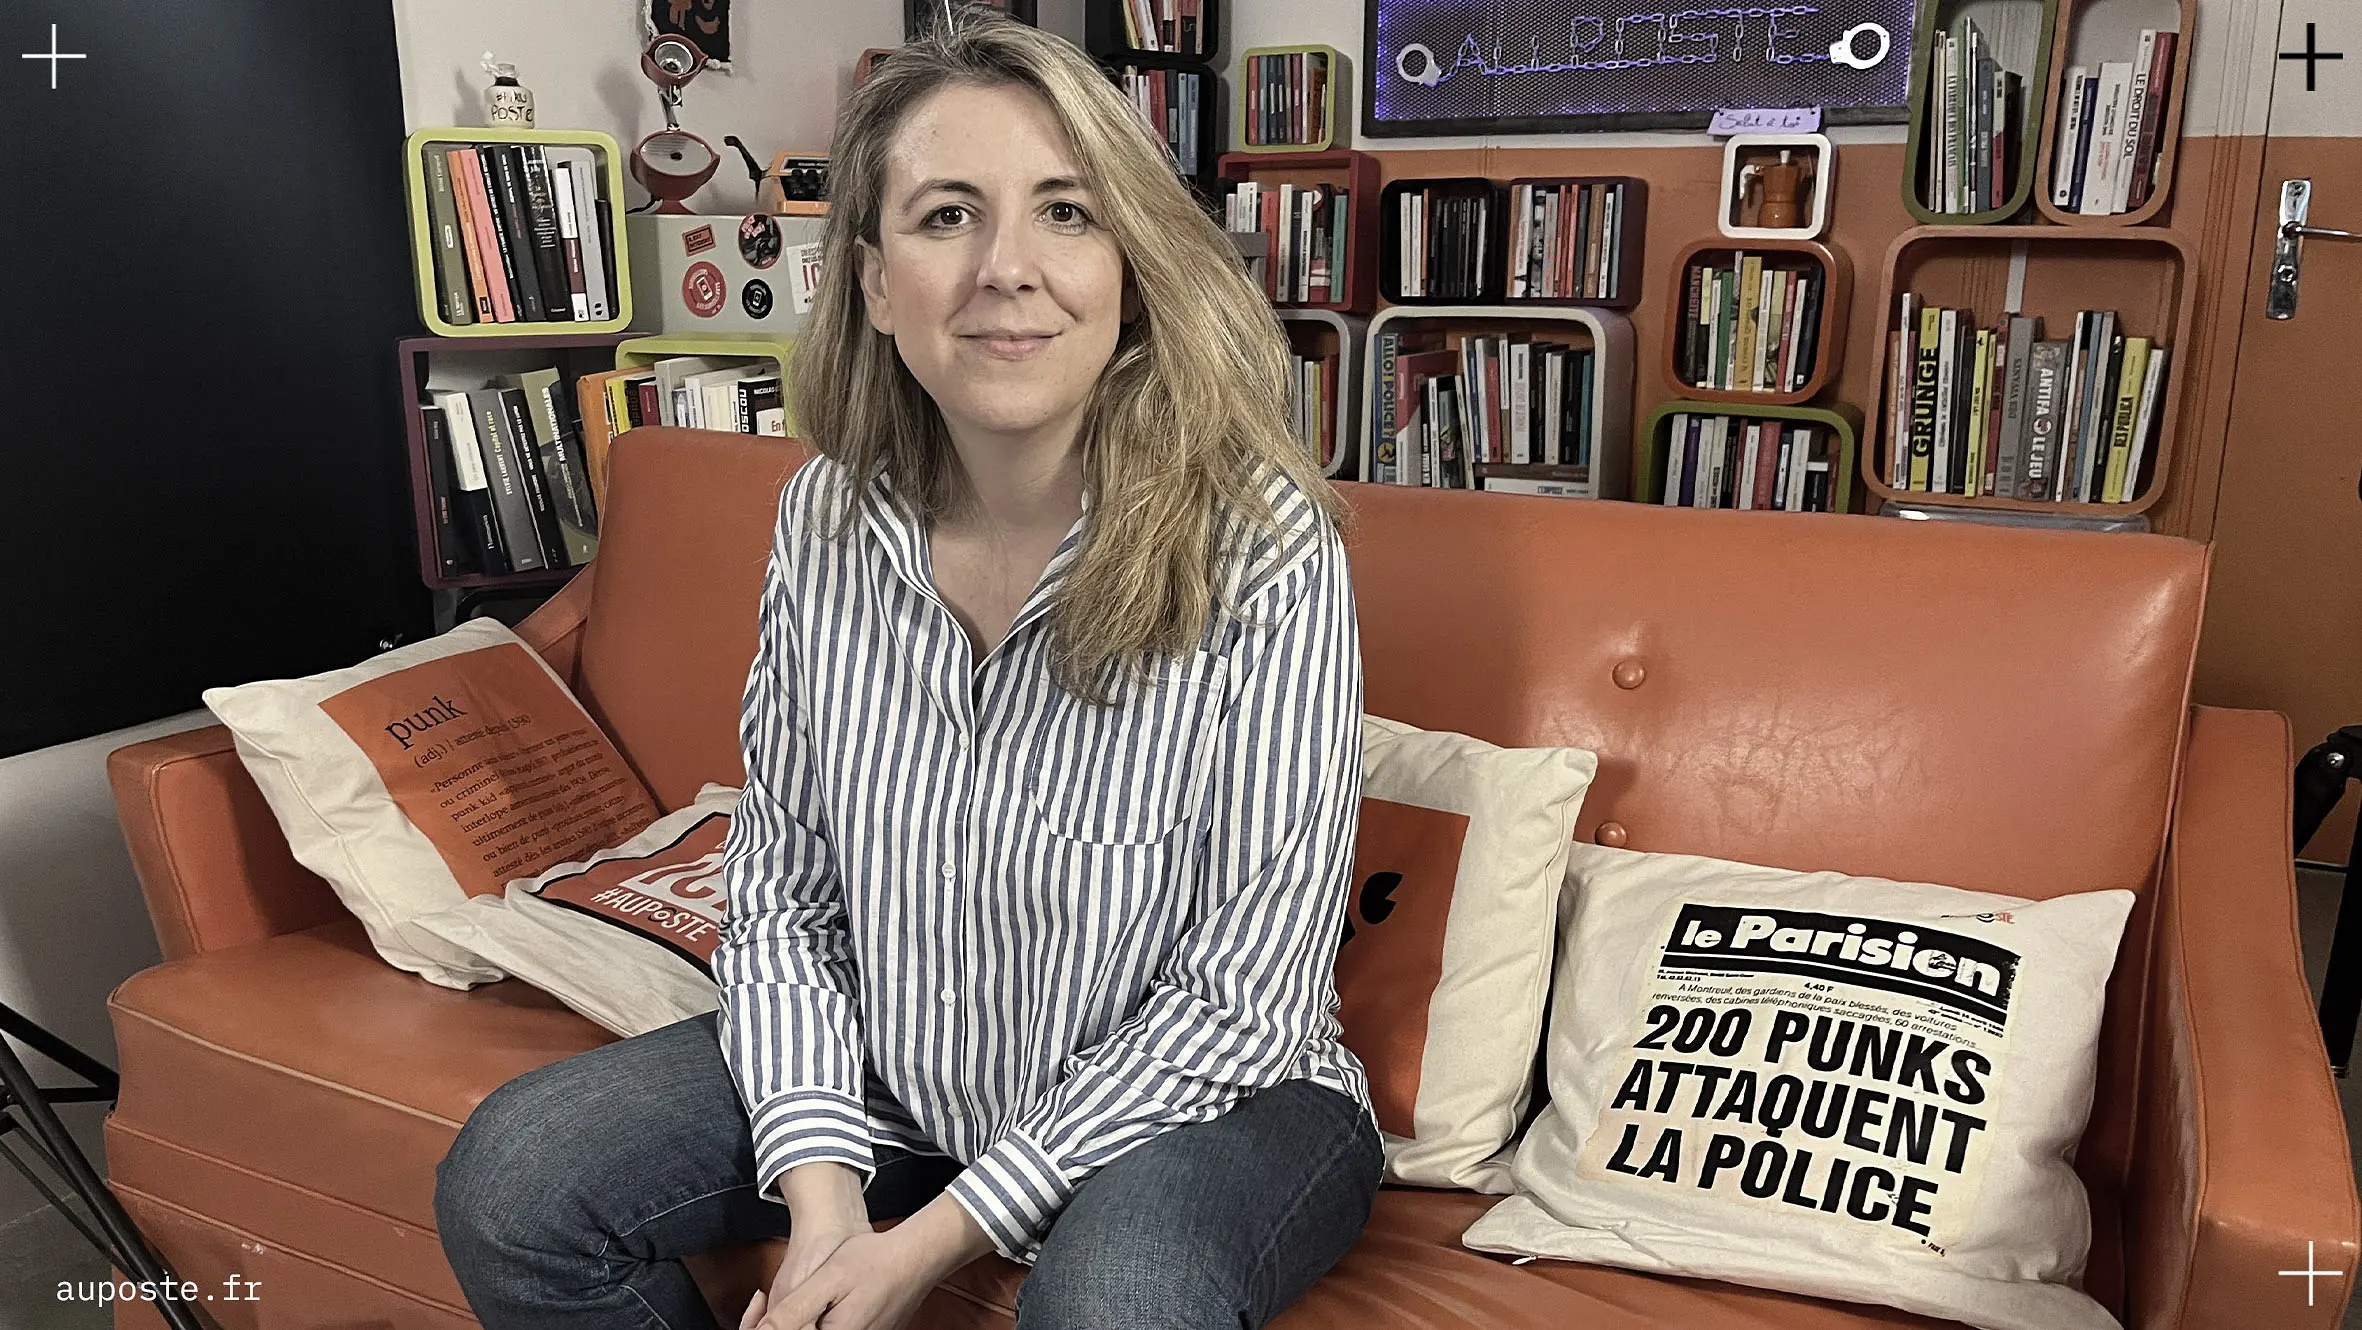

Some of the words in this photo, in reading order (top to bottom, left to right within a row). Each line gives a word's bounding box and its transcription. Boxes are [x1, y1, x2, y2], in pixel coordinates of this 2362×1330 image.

[2130, 87, 2144, 119] DROIT
[2124, 138, 2136, 159] SOL
[1913, 347, 1938, 458] GRUNGE
[2036, 368, 2053, 416] ANTIFA
[542, 387, 566, 462] MULTINATIONALES
[2028, 450, 2044, 479] JEU
[385, 696, 467, 750] punk
[414, 744, 448, 768] (adj.)
[440, 798, 455, 808] ou
[455, 770, 499, 802] criminel
[1681, 920, 1722, 948] le
[1729, 915, 2000, 996] Parisien
[1687, 985, 1733, 995] Montreuil,
[1735, 987, 1751, 995] des
[1753, 987, 1796, 998] gardiens
[1798, 991, 1810, 999] de
[1813, 993, 1823, 1001] la
[1825, 995, 1847, 1009] paix
[1849, 1000, 1889, 1015] blessés,
[1892, 1009, 1912, 1019] des
[1914, 1013, 1957, 1031] voitures
[1705, 995, 1721, 1004] des
[1895, 1018, 1909, 1028] 60
[1633, 1005, 1753, 1057] 200
[1764, 1010, 1991, 1105] PUNKS
[1611, 1058, 1987, 1174] ATTAQUENT
[1606, 1123, 1683, 1183] LA
[1697, 1133, 1938, 1237] POLICE
